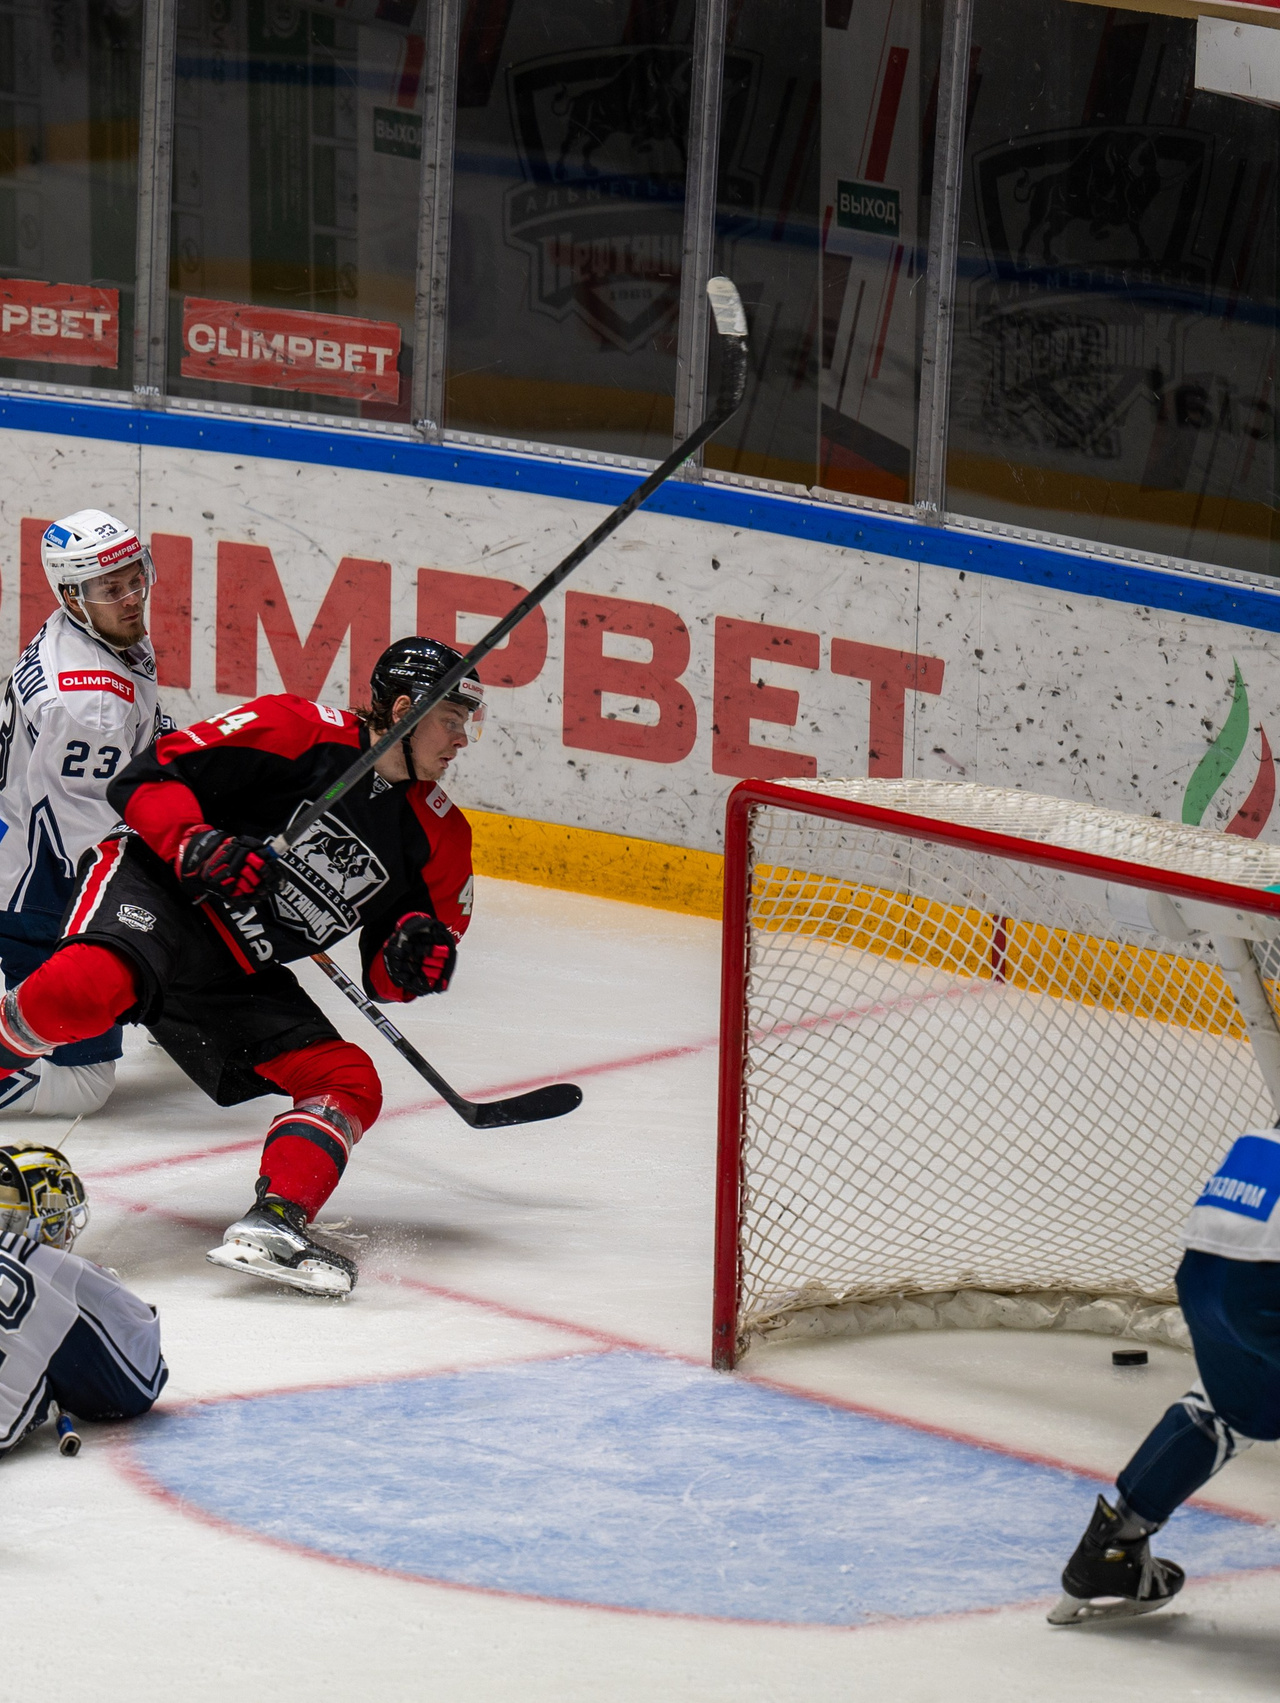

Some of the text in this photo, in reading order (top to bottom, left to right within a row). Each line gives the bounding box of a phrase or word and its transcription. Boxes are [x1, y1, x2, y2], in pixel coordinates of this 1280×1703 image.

[840, 193, 896, 225] ВЫХОД
[186, 322, 393, 377] OLIMPBET
[94, 523, 118, 539] 23
[101, 542, 140, 563] OLIMPBET
[389, 668, 416, 677] CCM
[62, 677, 132, 696] OLIMPBET
[462, 682, 484, 695] OLIMPB
[61, 739, 122, 780] 23
[281, 852, 354, 920] ЛЬМЕТЬЕВСК
[328, 963, 402, 1042] TRUE
